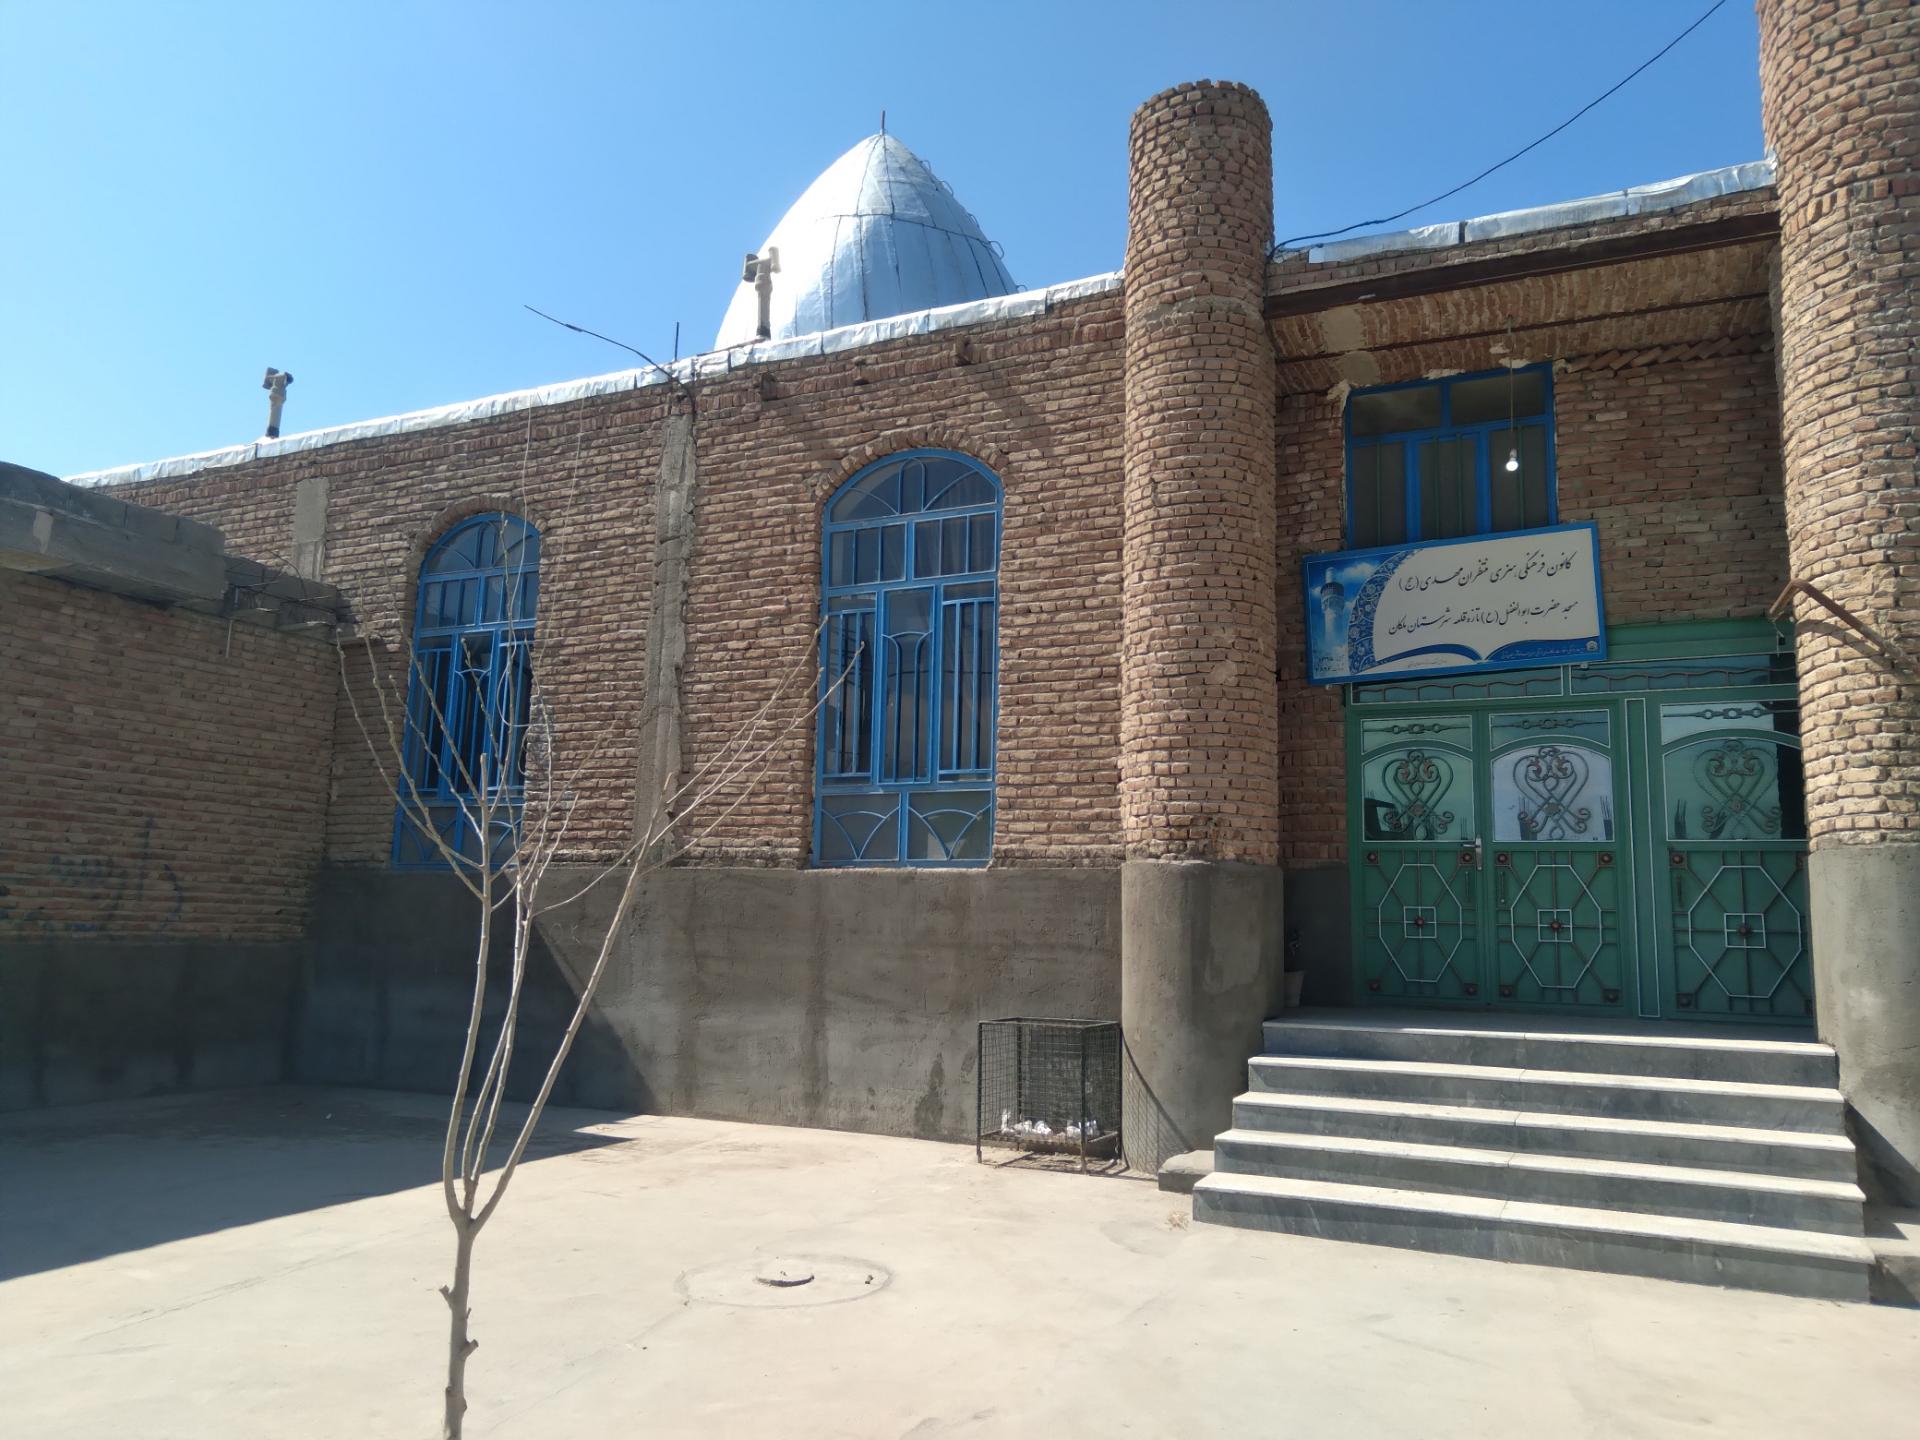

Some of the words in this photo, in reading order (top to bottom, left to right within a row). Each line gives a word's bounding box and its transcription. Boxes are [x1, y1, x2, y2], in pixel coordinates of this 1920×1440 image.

[1547, 550, 1577, 576] کانون
[1420, 567, 1463, 591] مهدی
[1530, 599, 1560, 617] حضرت
[1562, 601, 1578, 620] مسجد
